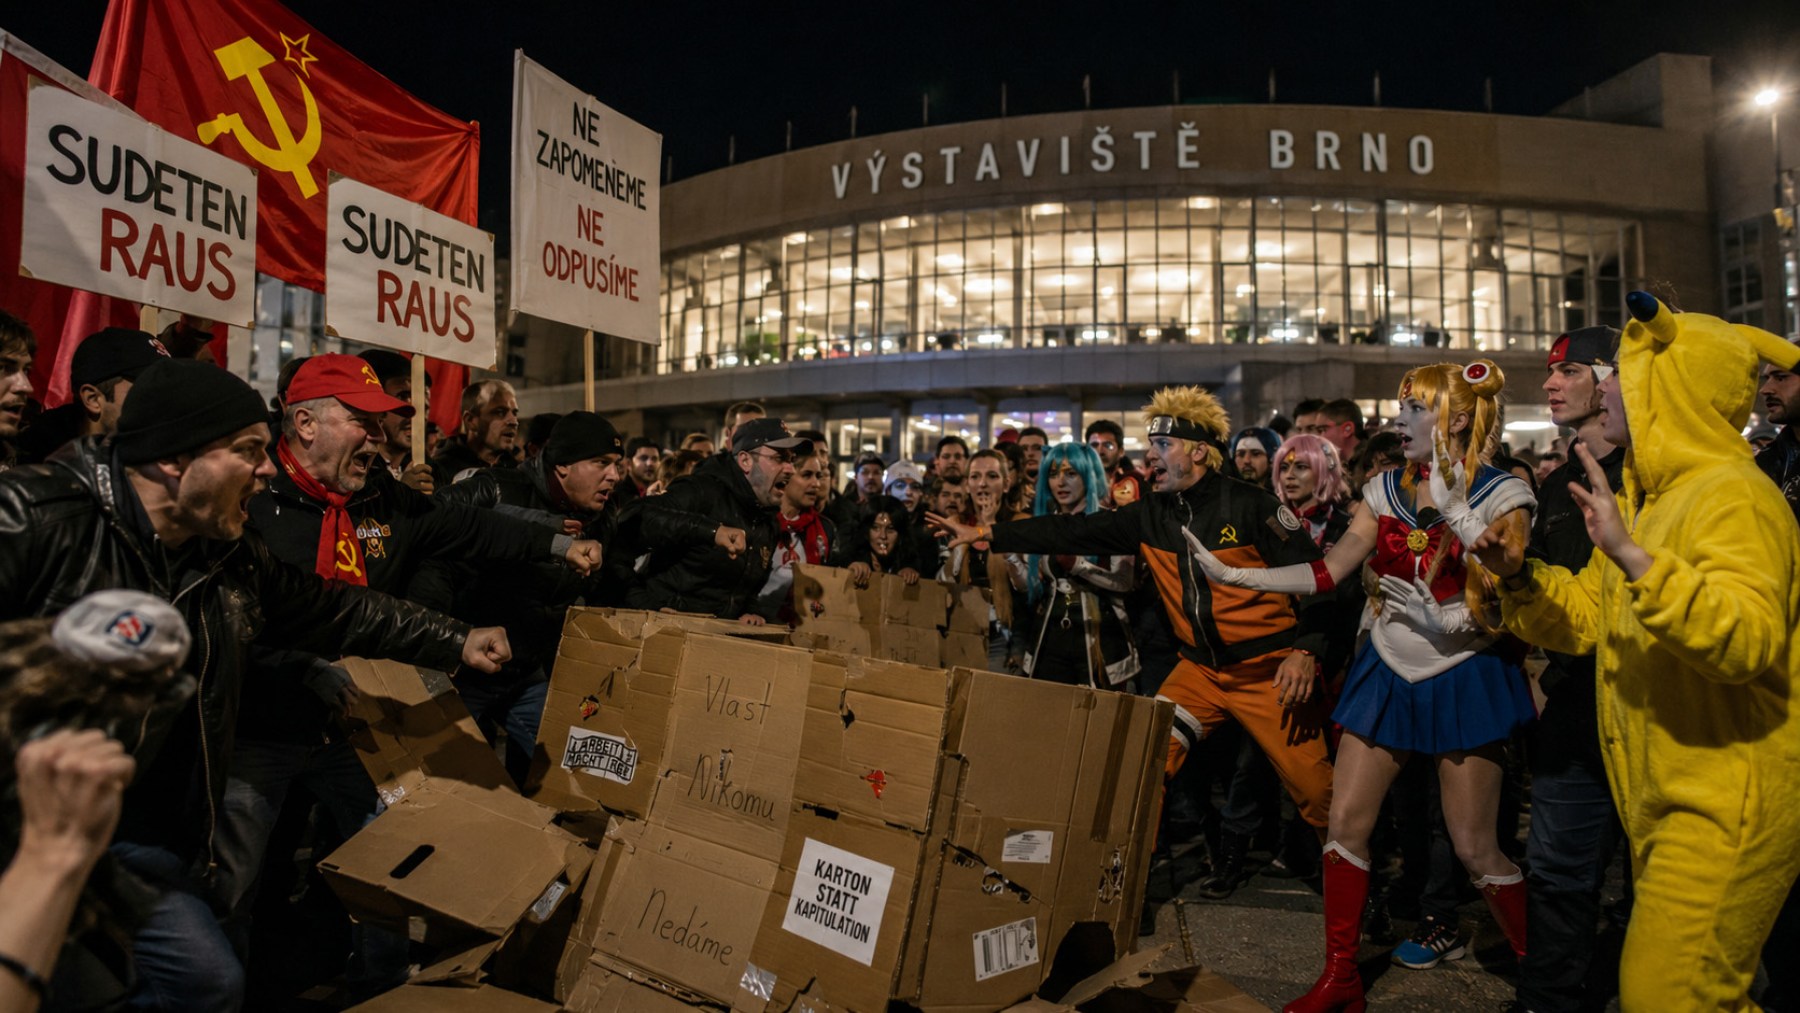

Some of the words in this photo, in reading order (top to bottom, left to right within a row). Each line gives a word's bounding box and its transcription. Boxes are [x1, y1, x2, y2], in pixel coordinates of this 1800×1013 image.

[573, 101, 600, 147] NE
[46, 124, 247, 241] SUDETEN
[831, 121, 1200, 199] VÝSTAVIŠTĚ
[1269, 129, 1434, 175] BRNO
[100, 207, 236, 301] RAUS
[341, 205, 485, 294] SUDETEN
[577, 203, 604, 247] NE
[542, 241, 640, 303] ODPUSÍME
[377, 269, 475, 343] RAUS
[706, 675, 771, 725] Vlast
[687, 753, 775, 822] Nikomu
[814, 858, 872, 896] KARTON
[816, 883, 860, 915] STATT
[794, 898, 871, 944] KAPITULATION
